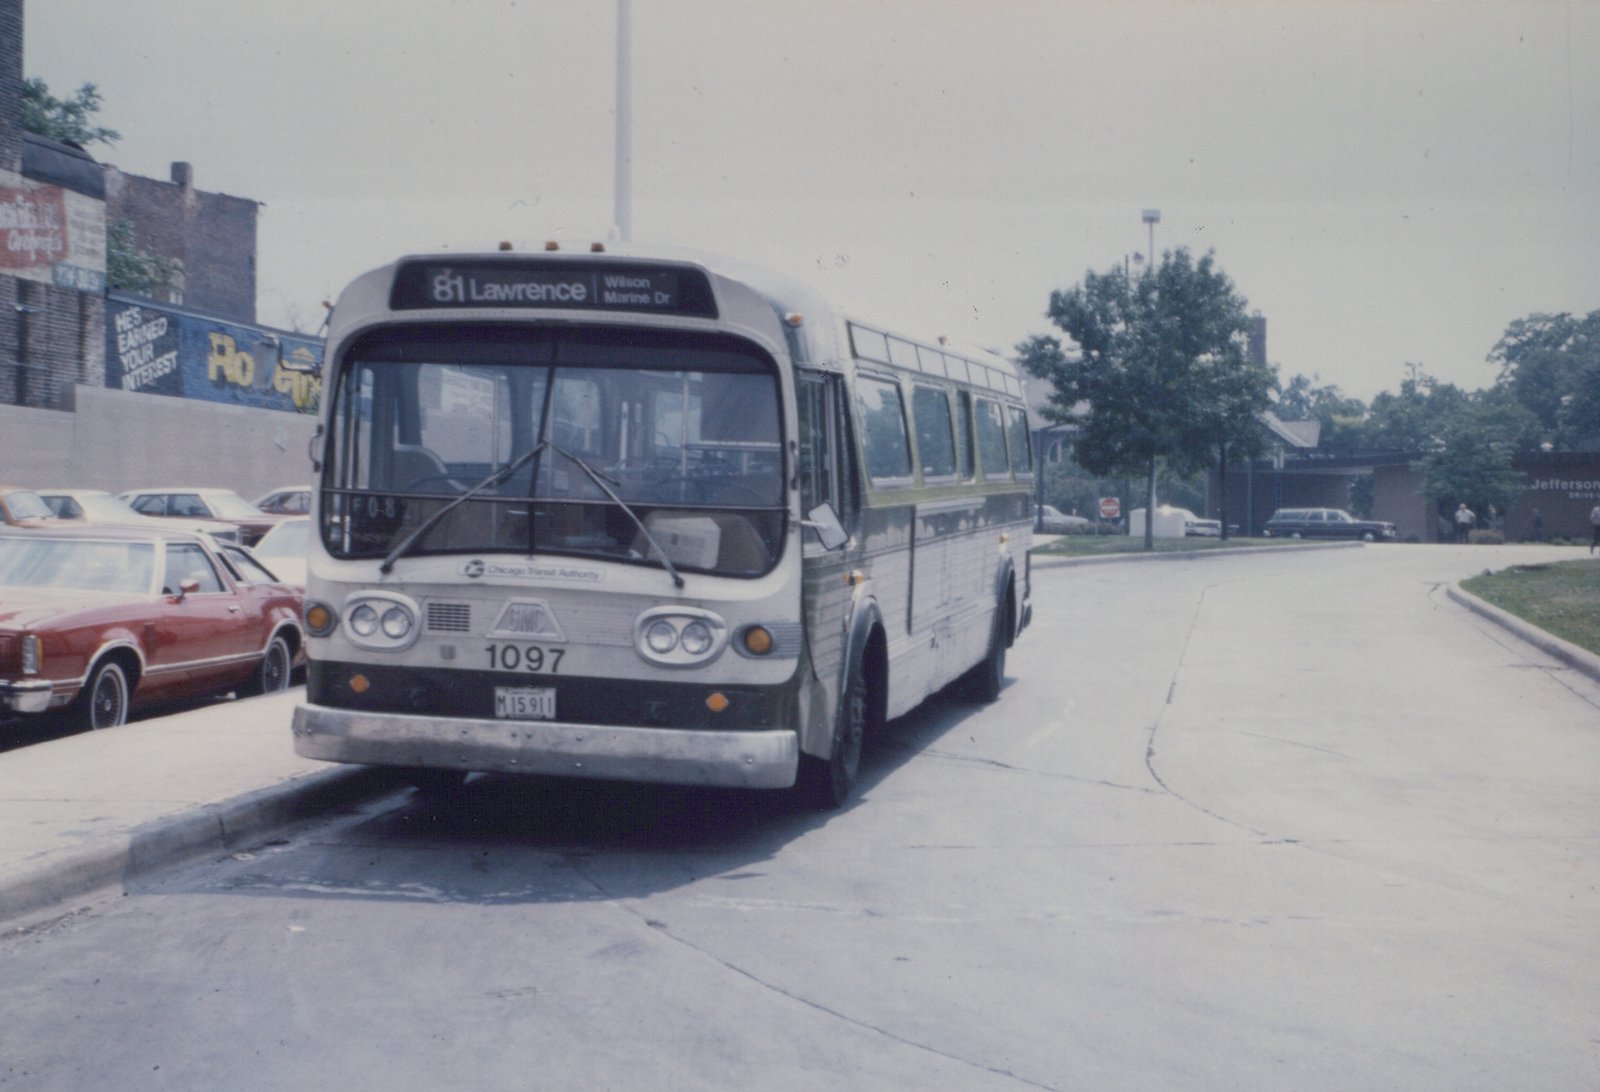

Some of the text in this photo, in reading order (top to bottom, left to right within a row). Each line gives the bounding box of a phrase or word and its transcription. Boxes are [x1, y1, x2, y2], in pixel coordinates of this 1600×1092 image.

[432, 275, 588, 302] 81 Lawrence
[603, 275, 651, 288] Wilson
[603, 291, 671, 304] Marine Dr
[119, 342, 154, 372] YOUR
[121, 350, 179, 391] INTEREST
[1530, 479, 1600, 490] Jefferson
[487, 564, 600, 580] Chicago Transit Authority
[484, 643, 566, 674] 1097
